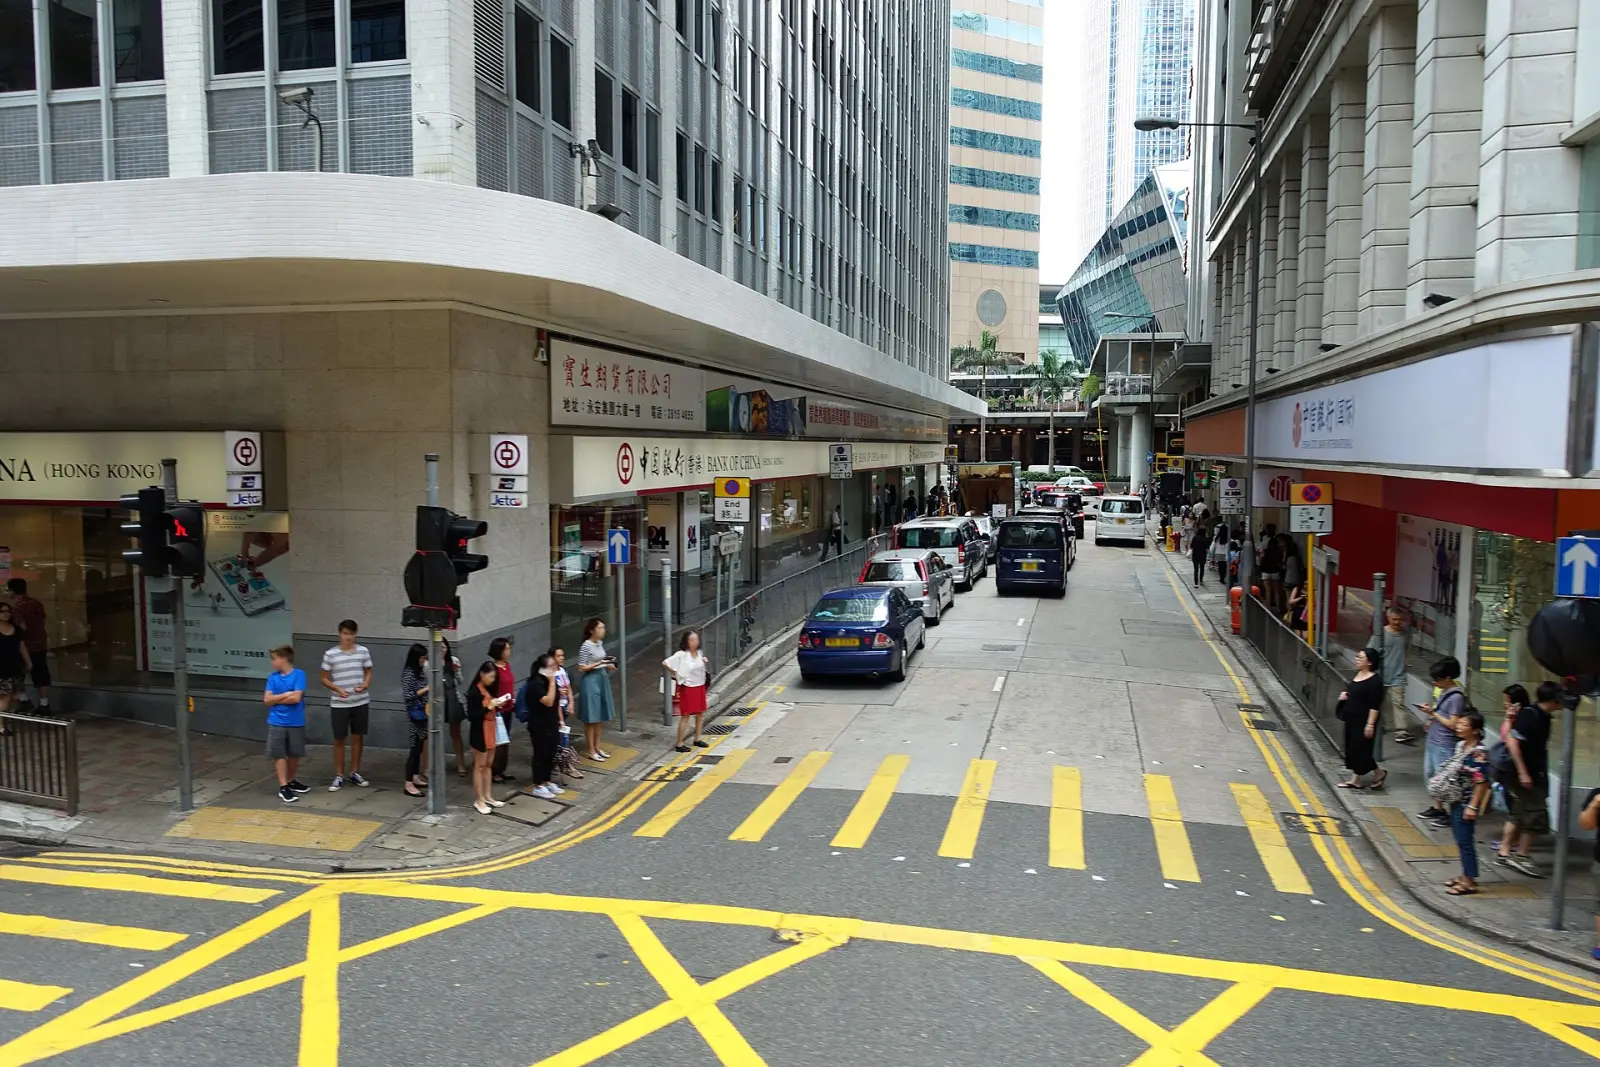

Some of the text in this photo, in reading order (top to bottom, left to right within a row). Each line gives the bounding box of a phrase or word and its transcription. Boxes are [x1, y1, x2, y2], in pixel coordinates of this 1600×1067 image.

[563, 354, 672, 399] 寶生期貨有限公司
[708, 455, 728, 473] BANK
[729, 455, 739, 472] OF
[739, 454, 761, 472] CHINA
[44, 462, 100, 479] (HONG
[107, 463, 162, 480] KONG)
[724, 500, 741, 508] End
[1317, 507, 1325, 516] 7
[1317, 520, 1325, 529] 7
